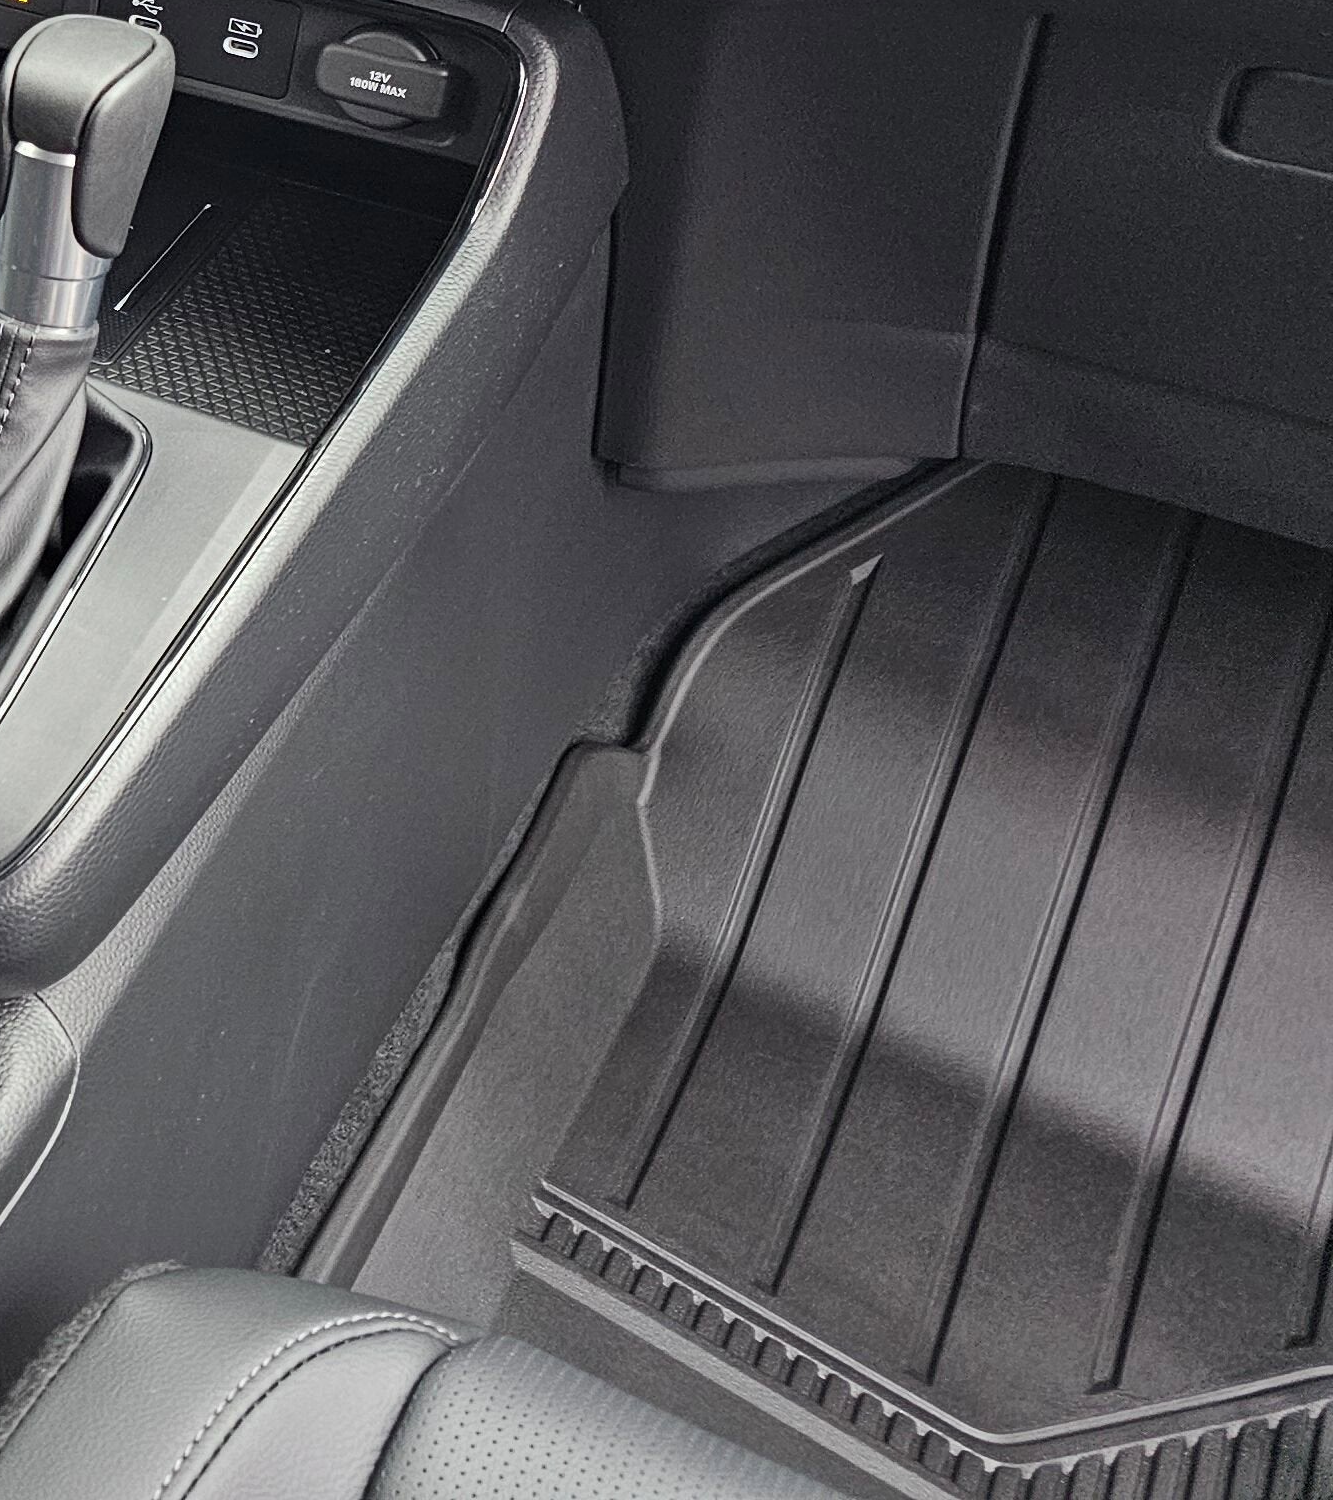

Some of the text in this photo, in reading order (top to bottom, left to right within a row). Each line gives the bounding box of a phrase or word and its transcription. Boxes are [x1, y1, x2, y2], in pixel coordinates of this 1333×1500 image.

[369, 70, 392, 84] 12V
[350, 76, 408, 99] 180W MAX
